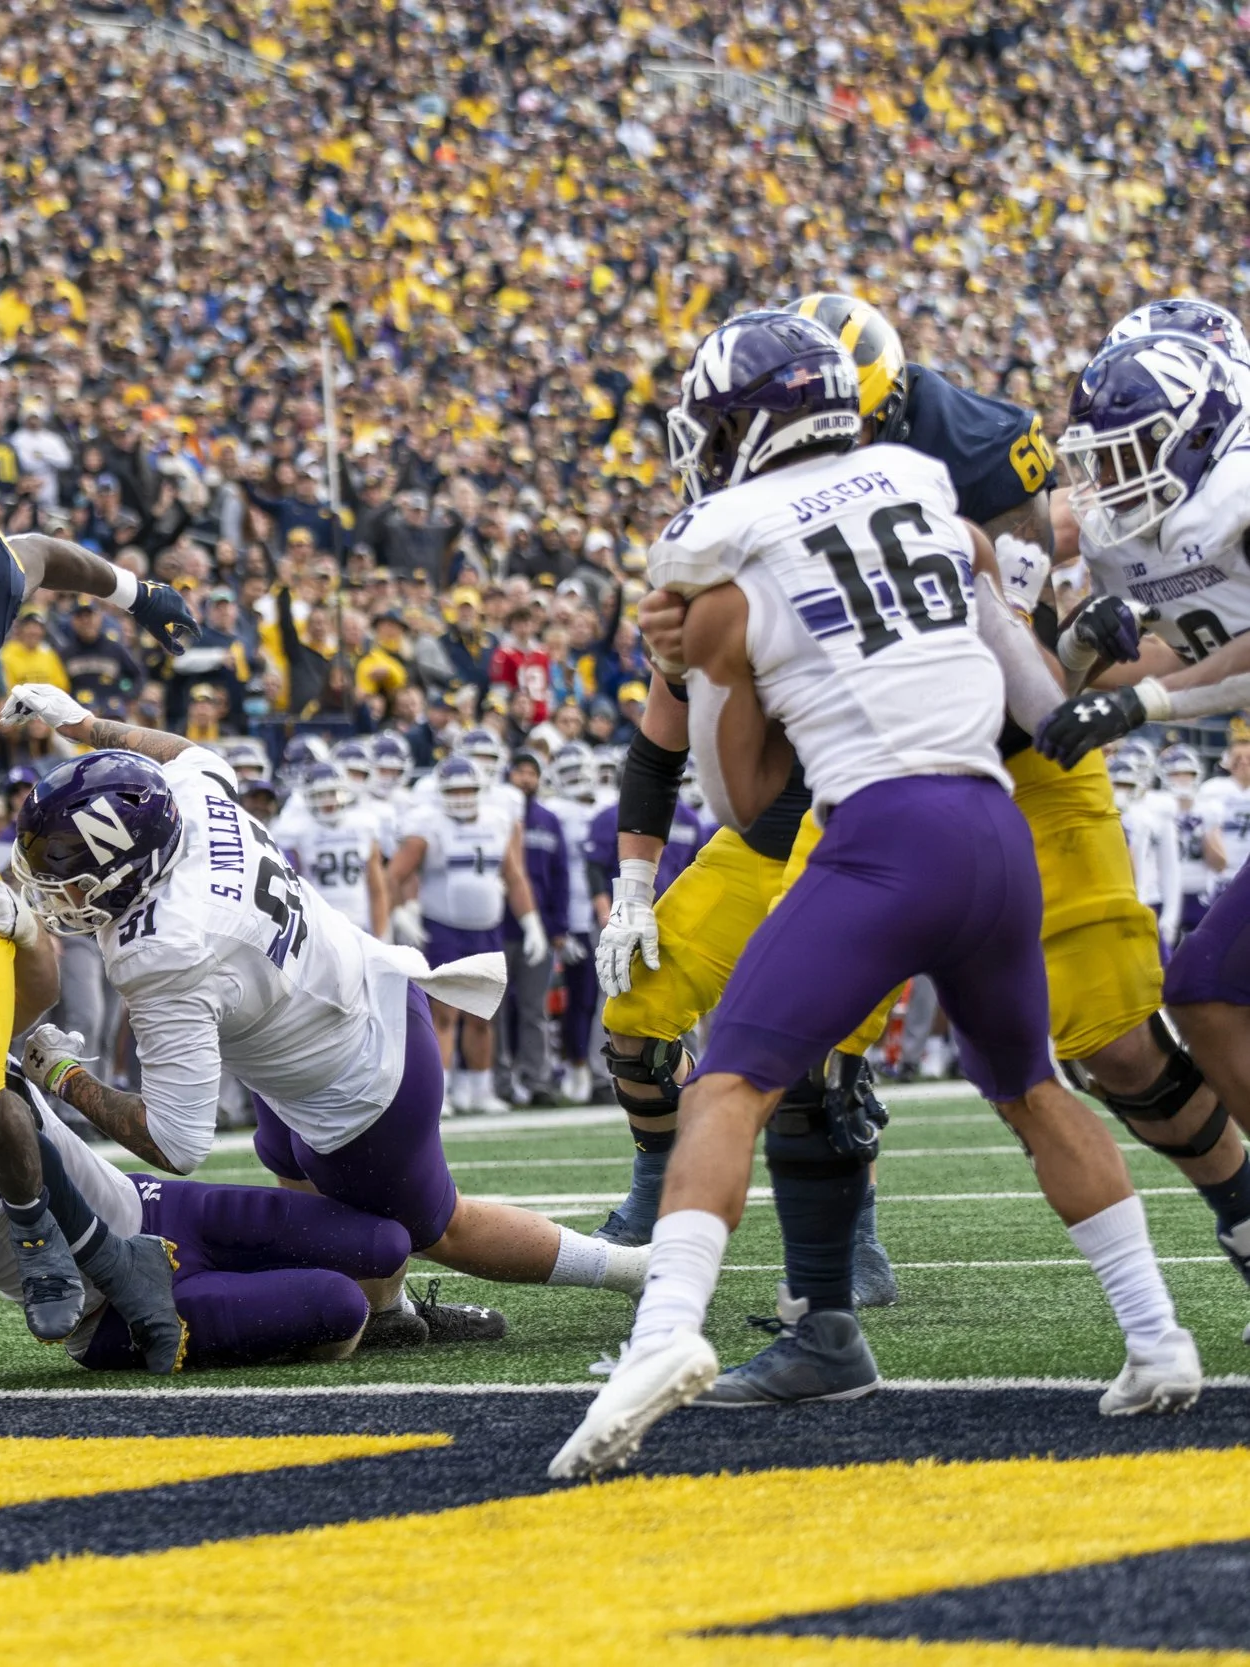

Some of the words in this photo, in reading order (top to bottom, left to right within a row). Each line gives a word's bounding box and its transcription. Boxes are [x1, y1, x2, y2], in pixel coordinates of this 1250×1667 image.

[693, 325, 742, 401] N
[1133, 340, 1204, 409] N
[813, 414, 854, 432] WILDCATS
[1009, 414, 1055, 493] 66
[791, 471, 899, 524] JOSEPH
[802, 502, 967, 658] 16
[1127, 564, 1229, 605] NORTHWESTERN
[71, 796, 135, 866] N
[205, 795, 244, 873] MILLER
[210, 883, 243, 902] S.
